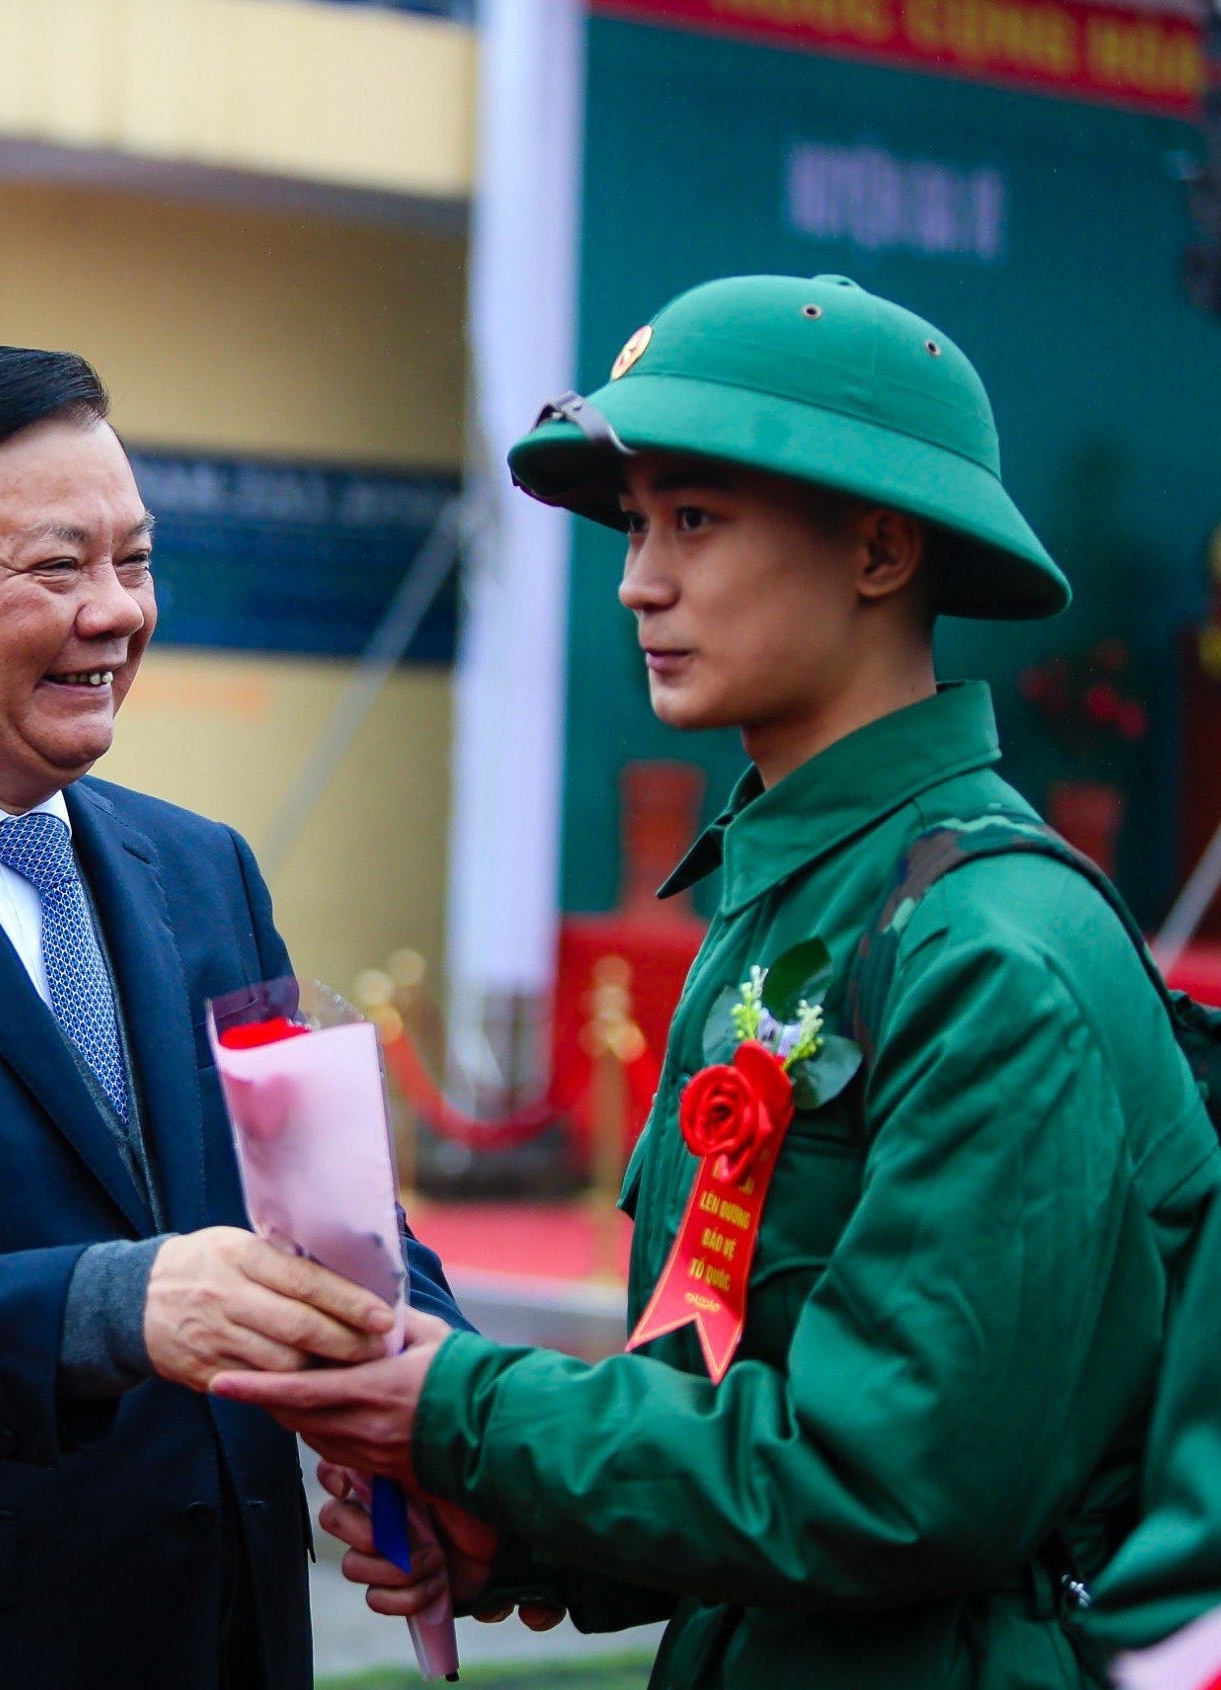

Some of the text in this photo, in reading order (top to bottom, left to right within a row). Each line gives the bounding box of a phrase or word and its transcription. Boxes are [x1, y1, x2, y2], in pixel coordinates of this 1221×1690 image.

[700, 1189, 720, 1214] LÊN
[703, 1227, 723, 1252] BẢO
[690, 1257, 730, 1290] TỔ QUỐC
